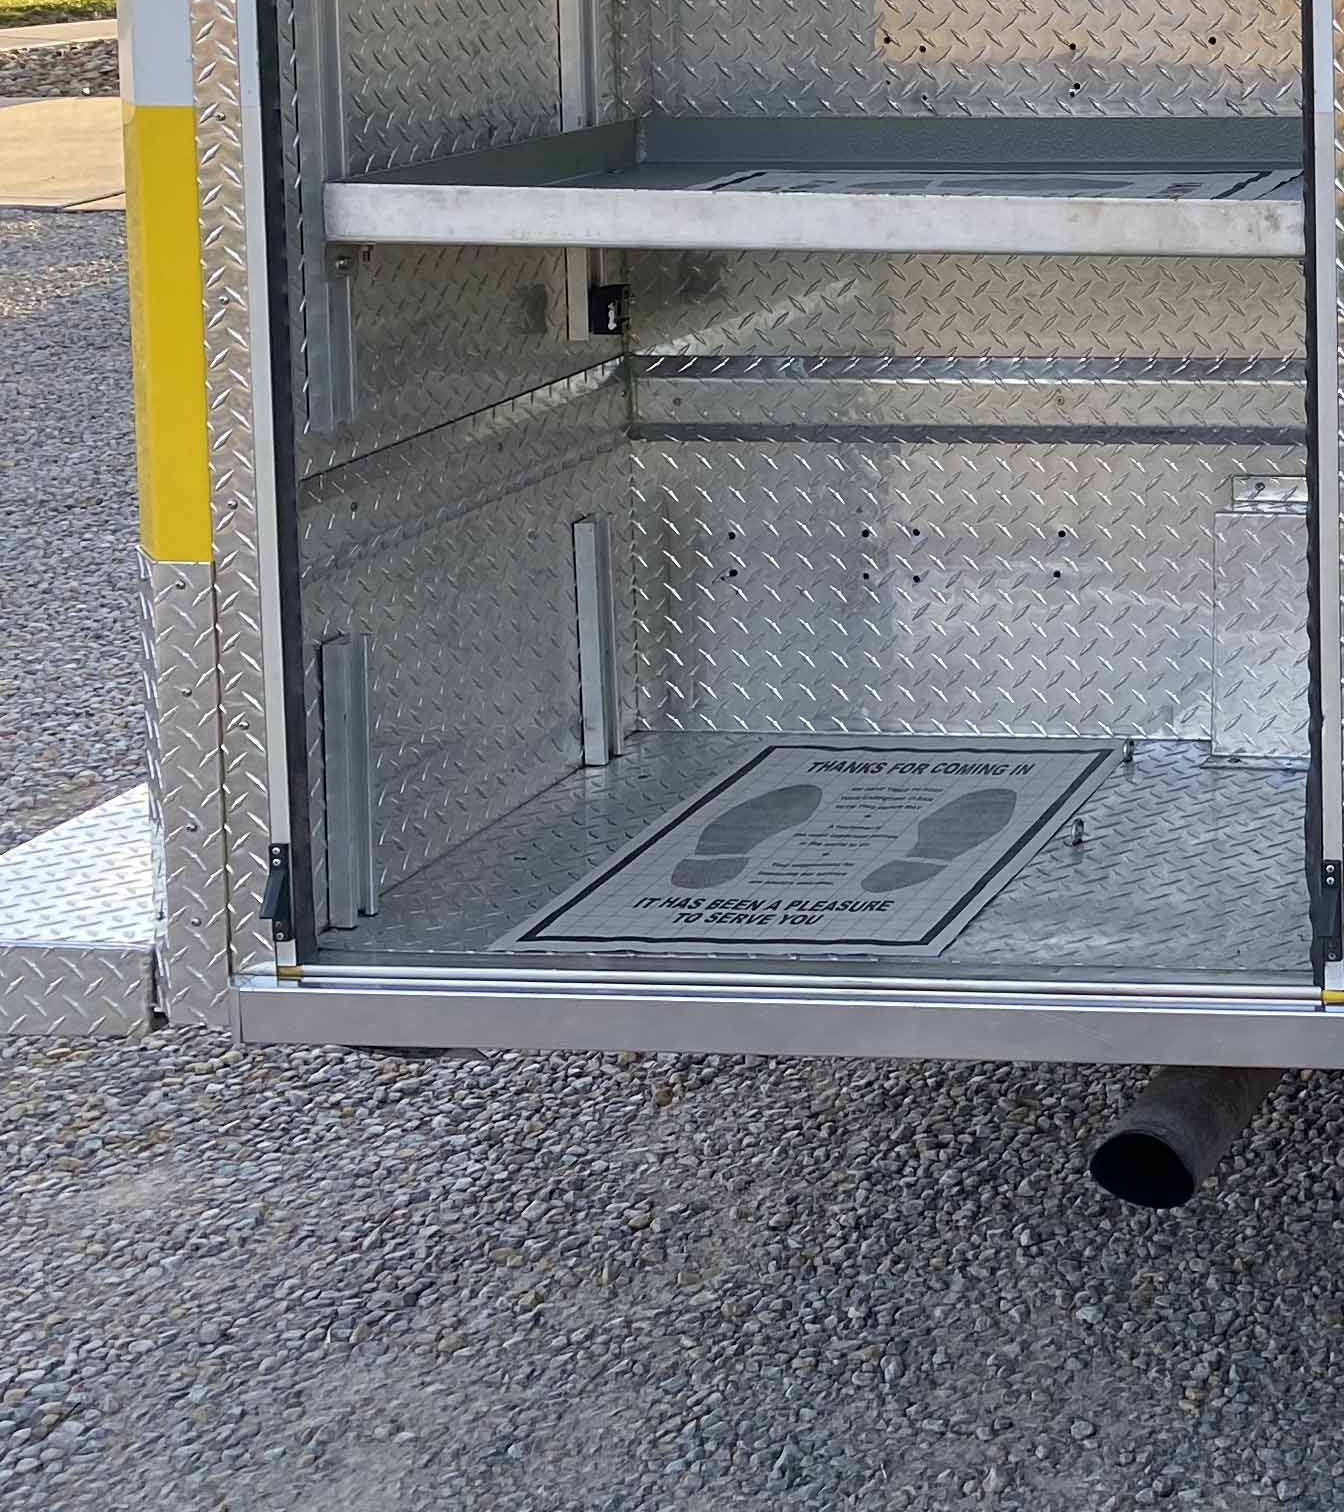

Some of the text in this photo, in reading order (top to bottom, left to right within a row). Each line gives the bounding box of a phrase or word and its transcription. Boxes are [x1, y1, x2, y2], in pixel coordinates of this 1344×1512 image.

[807, 761, 1035, 776] THANKS FOR COMING IN
[633, 897, 895, 913] IT HAS BEEN A PLEASURE
[672, 912, 825, 926] TO SERVE YOU
